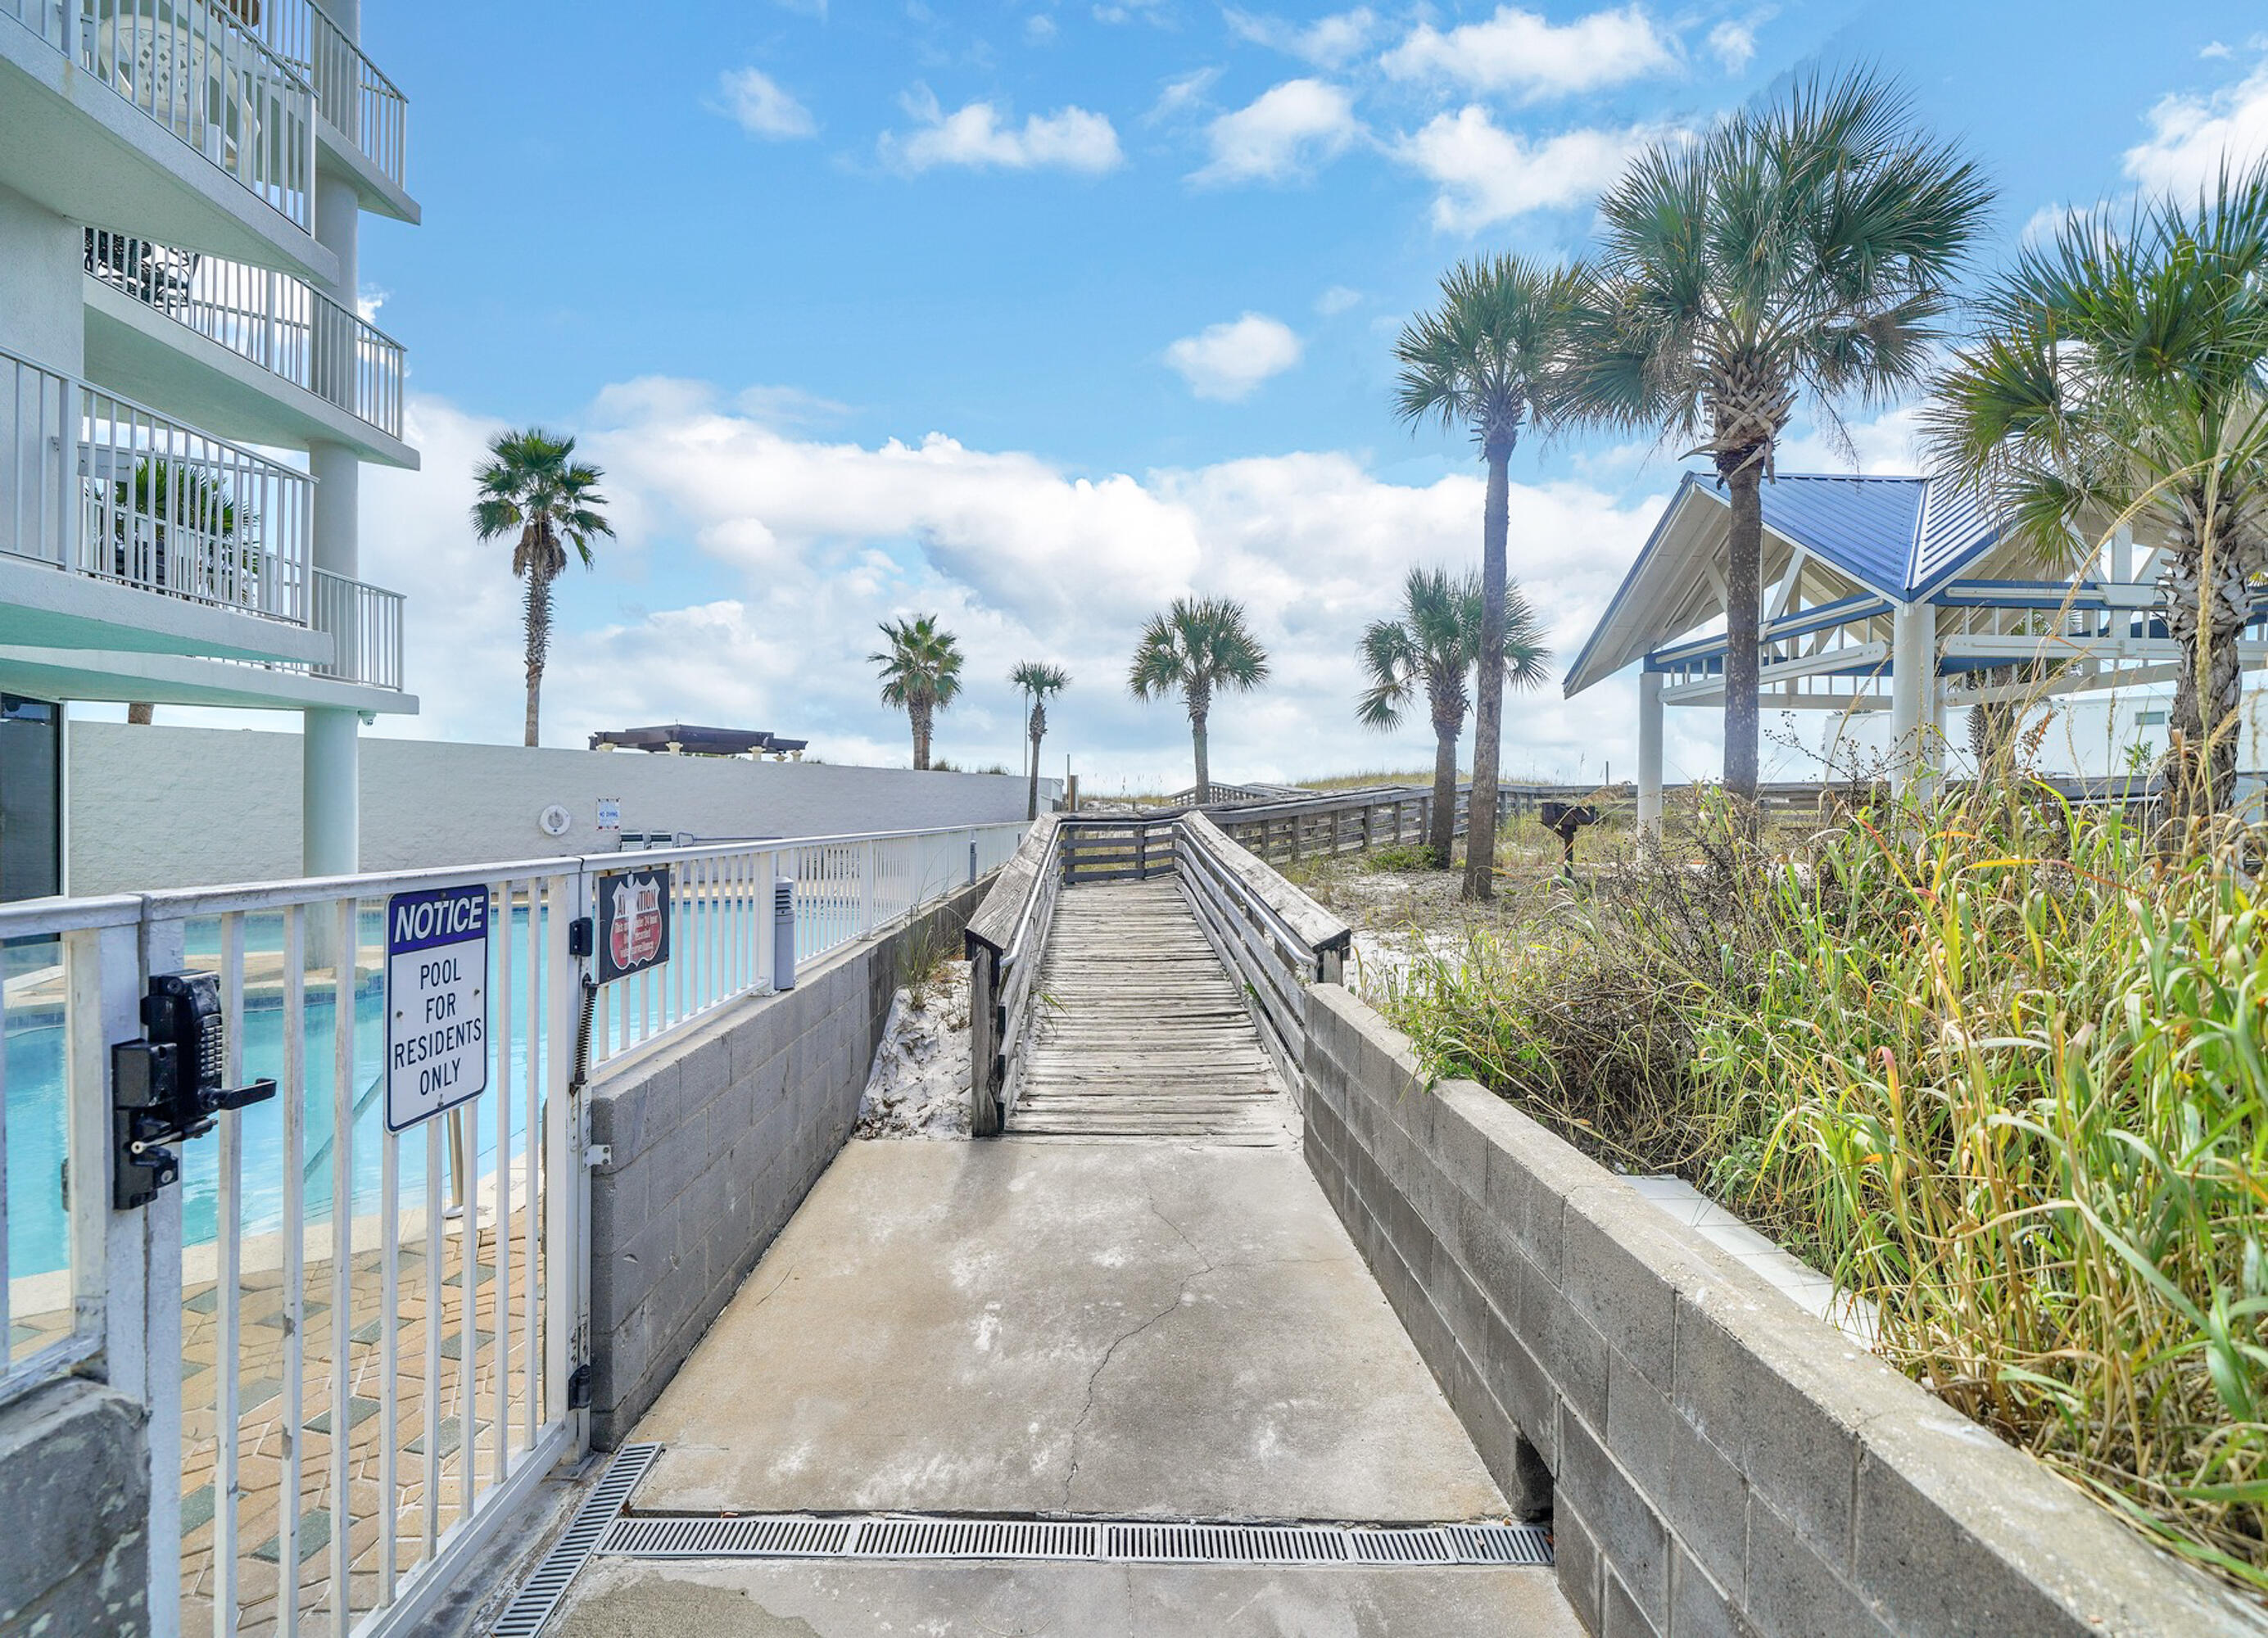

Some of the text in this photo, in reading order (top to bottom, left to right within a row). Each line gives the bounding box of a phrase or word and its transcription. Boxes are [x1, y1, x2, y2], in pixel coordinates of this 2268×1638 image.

[394, 895, 485, 943] NOTICE
[420, 957, 461, 990] POOL
[426, 993, 455, 1024] FOR
[394, 1017, 482, 1070] RESIDENTS
[419, 1057, 461, 1096] ONLY
